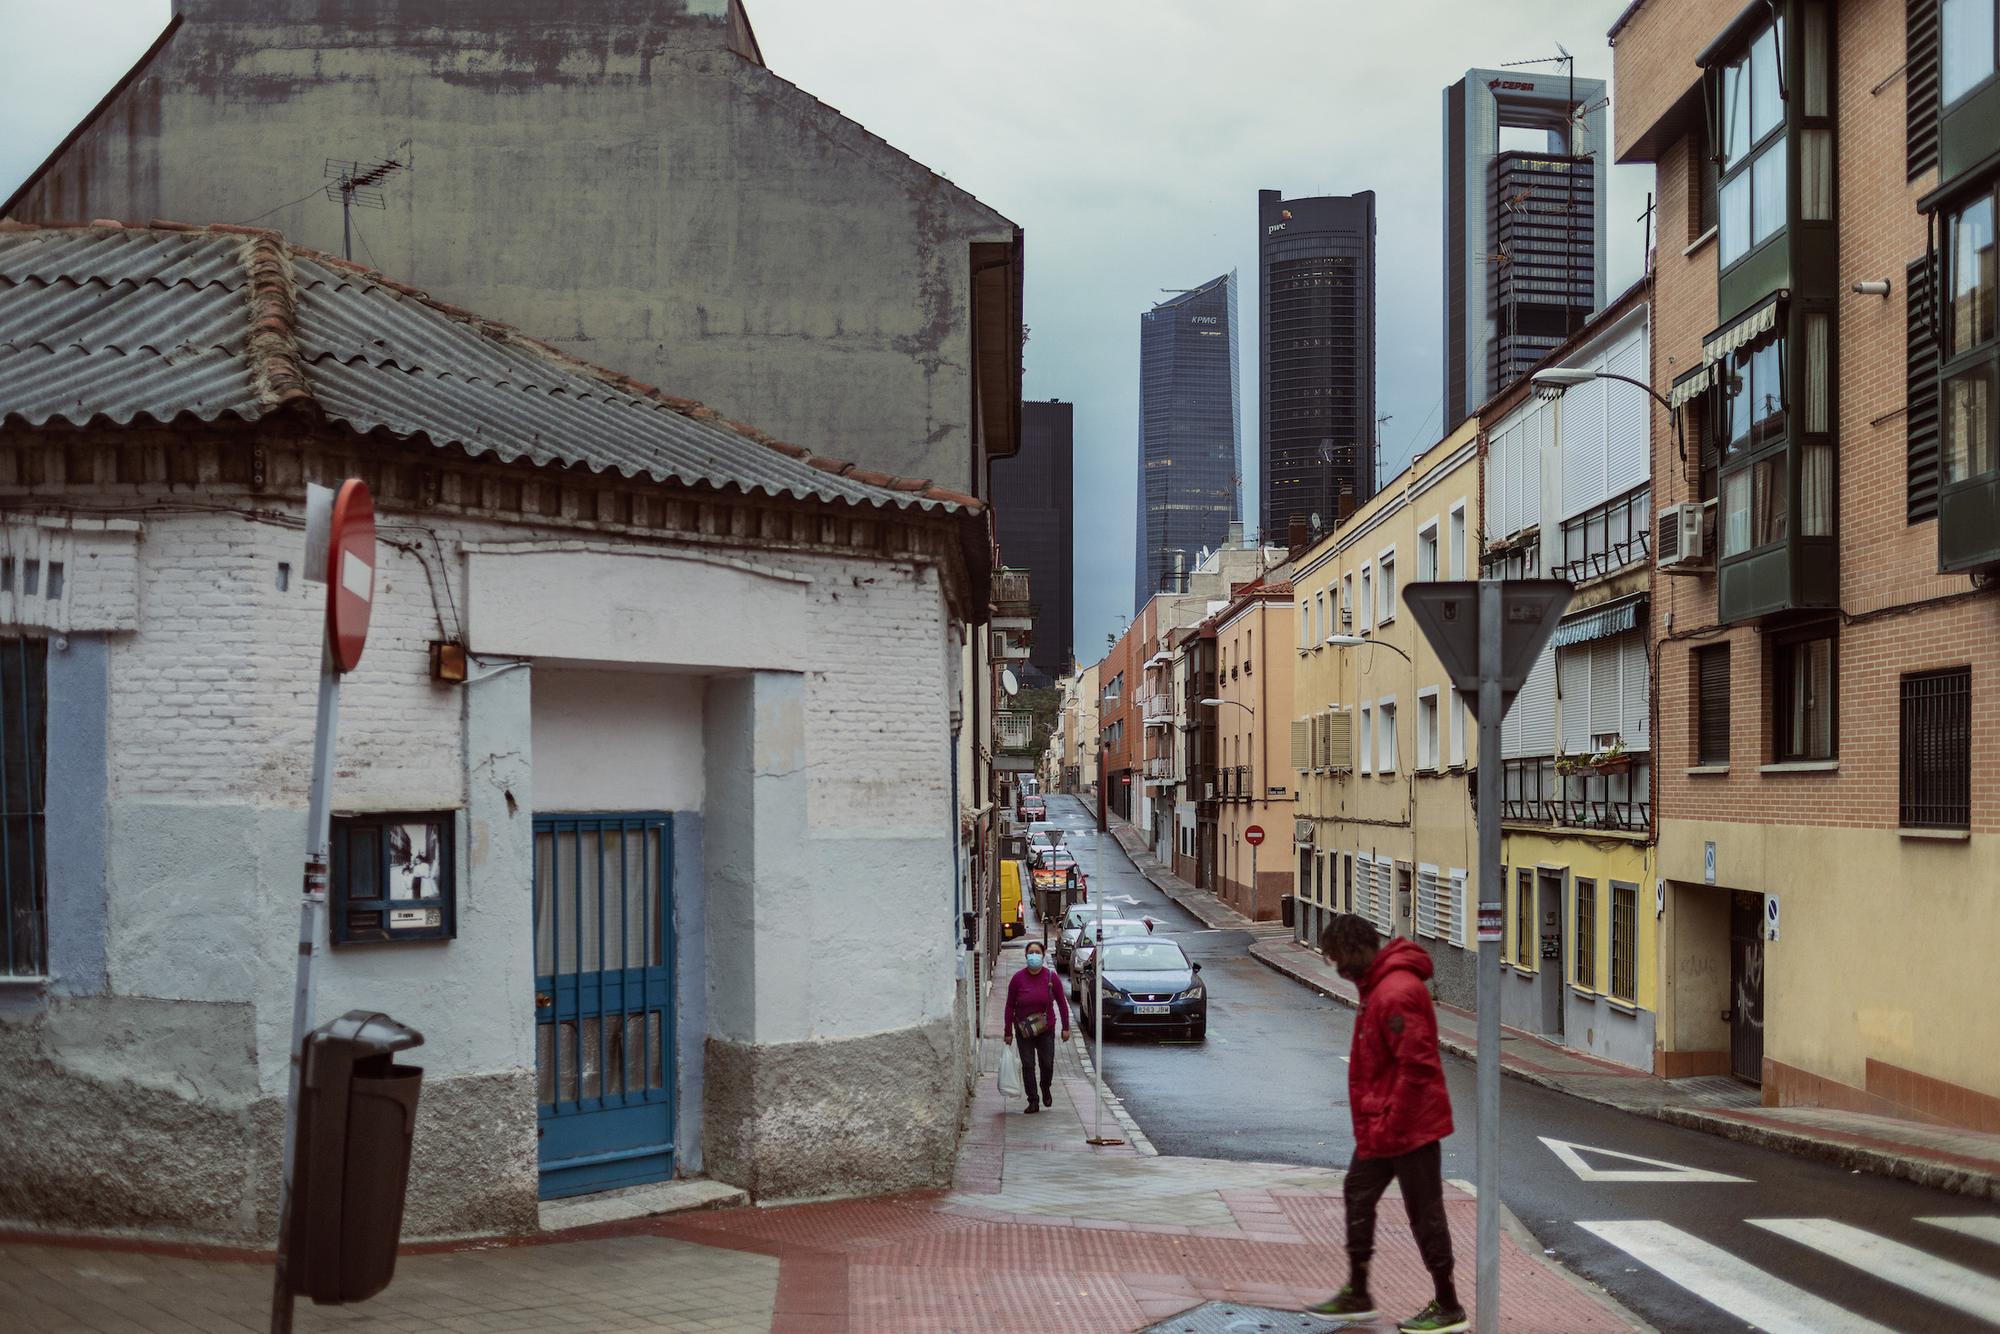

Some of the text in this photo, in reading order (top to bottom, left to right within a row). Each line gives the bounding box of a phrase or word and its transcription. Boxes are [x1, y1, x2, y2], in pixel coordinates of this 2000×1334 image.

[1502, 81, 1534, 91] CEPSA
[1268, 223, 1286, 235] pwc
[1191, 315, 1217, 324] KPMG
